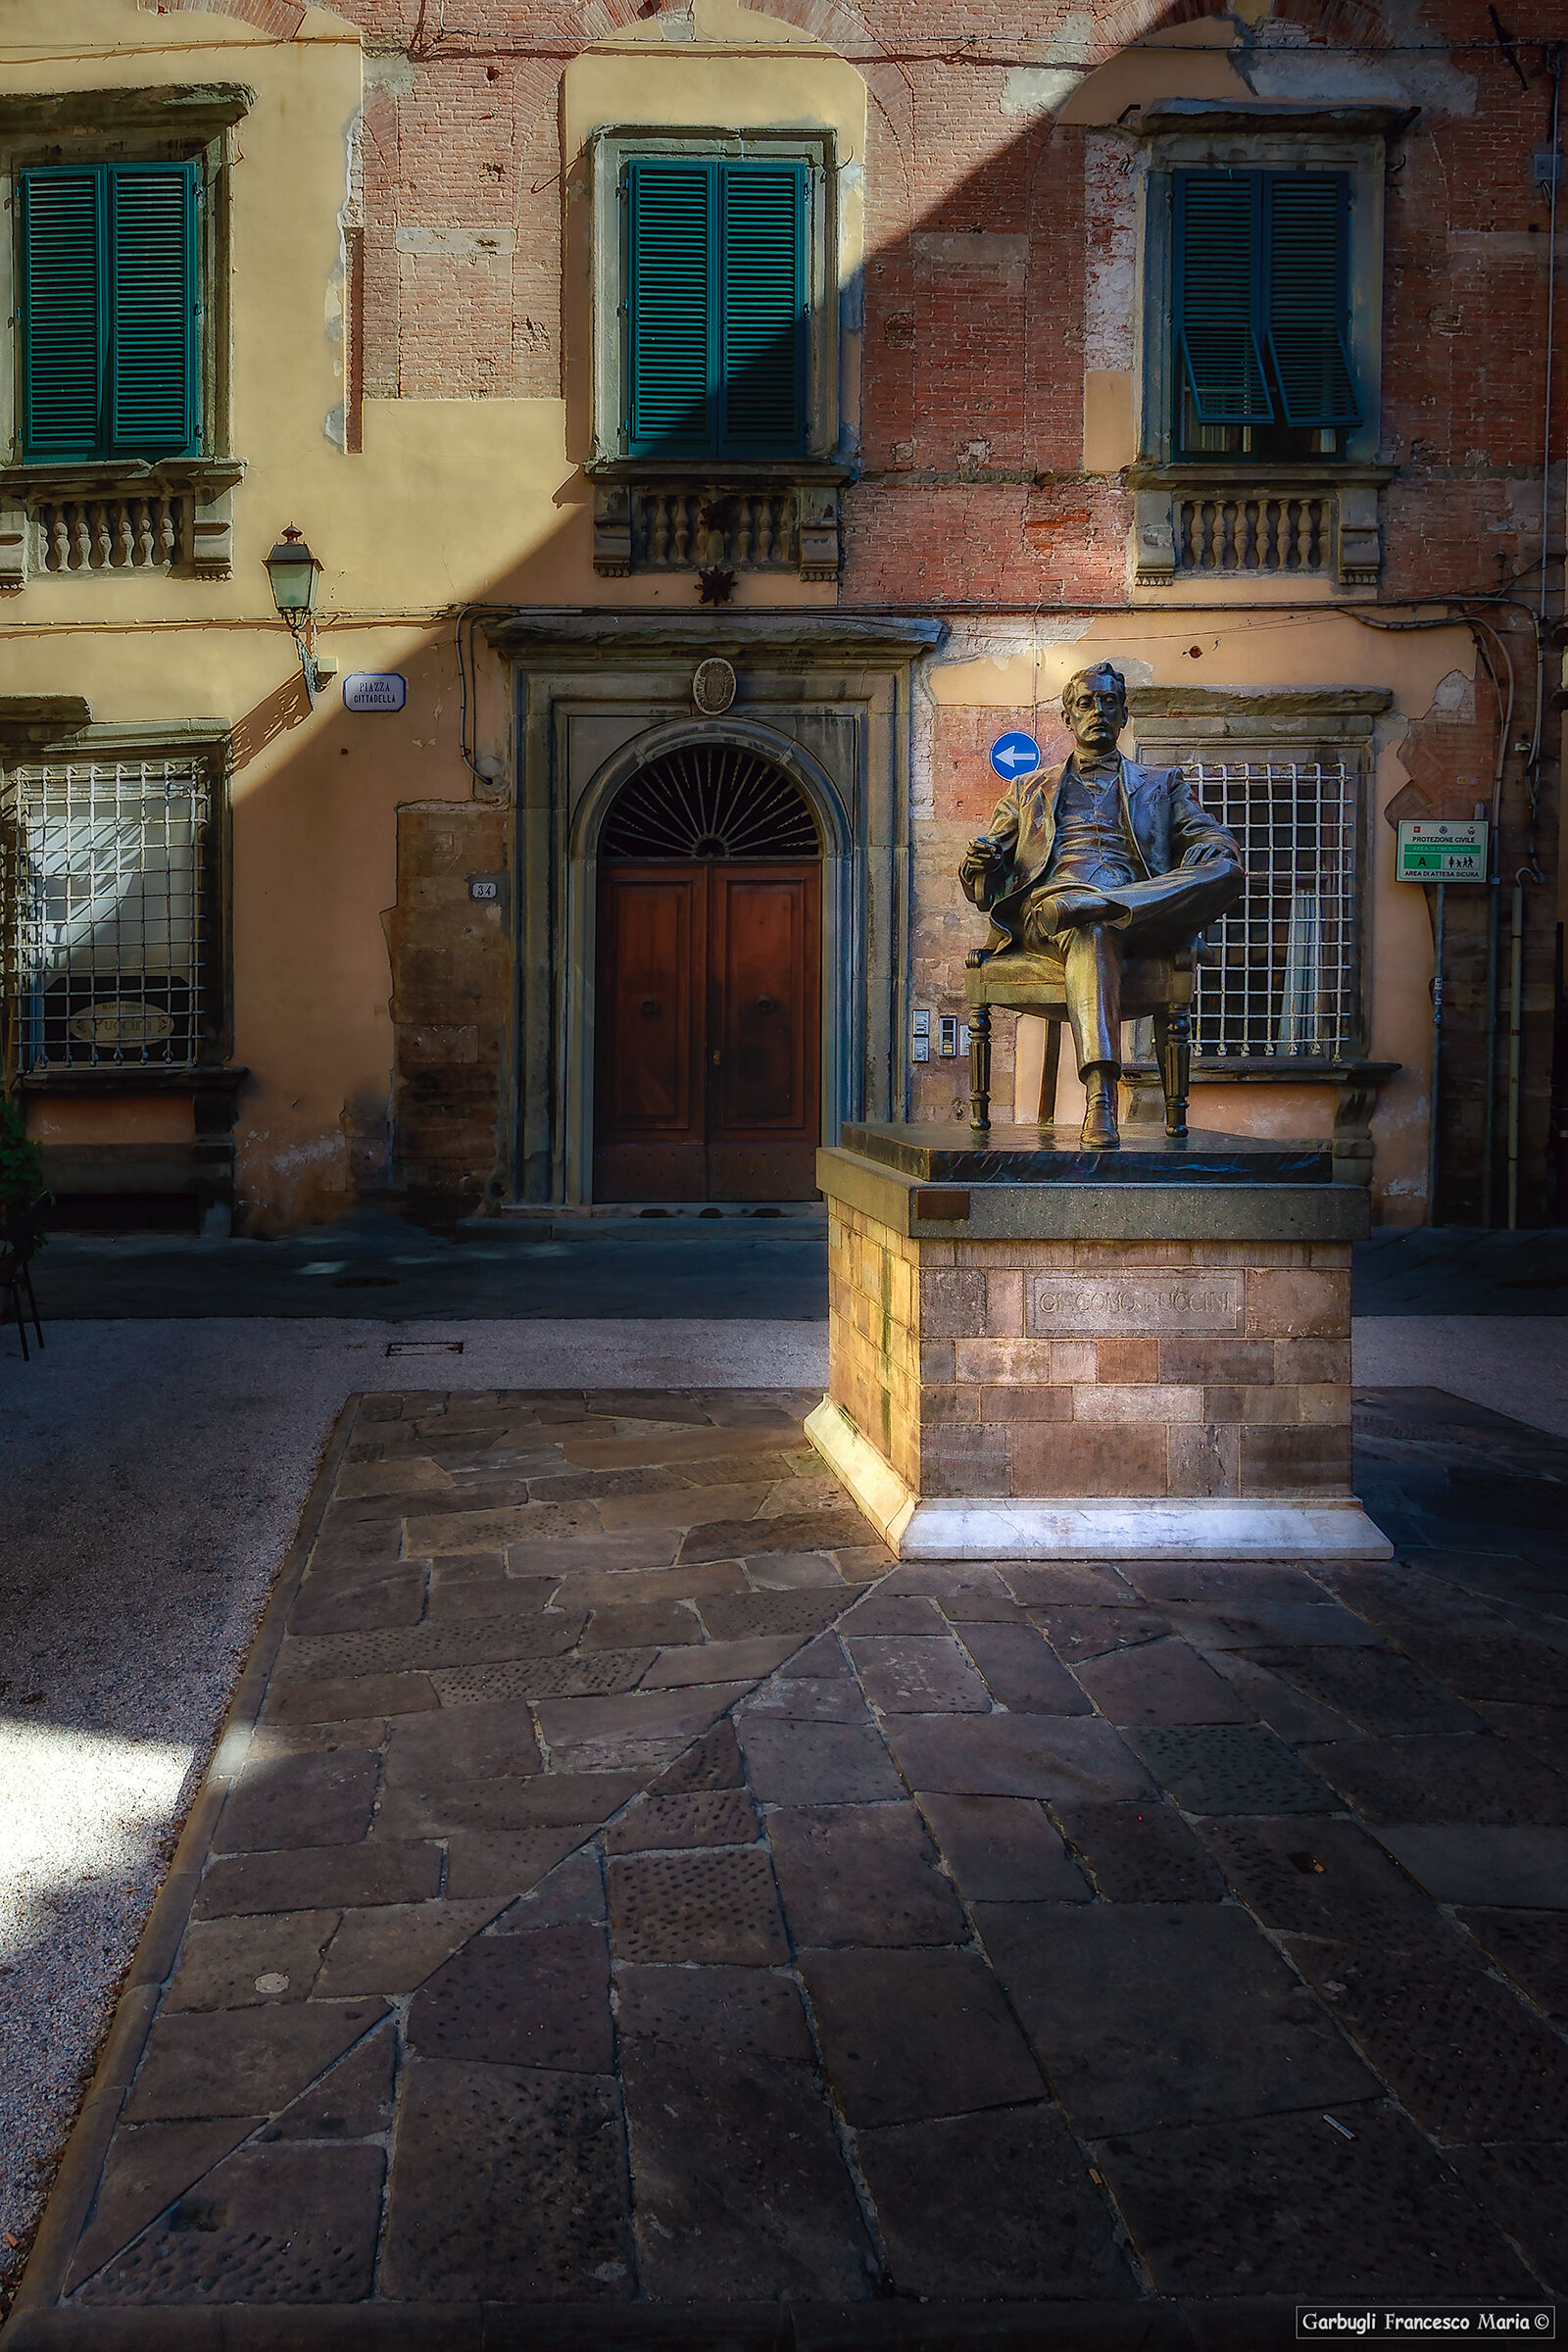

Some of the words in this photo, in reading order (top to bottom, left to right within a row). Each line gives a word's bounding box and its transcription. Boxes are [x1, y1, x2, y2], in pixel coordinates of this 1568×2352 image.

[360, 681, 390, 692] PIAZZA
[354, 694, 396, 704] CITTADELLA
[1417, 857, 1427, 867] A
[478, 884, 492, 896] 34
[1040, 1292, 1137, 1313] GIACOMO
[1144, 1292, 1230, 1313] PUCCINI
